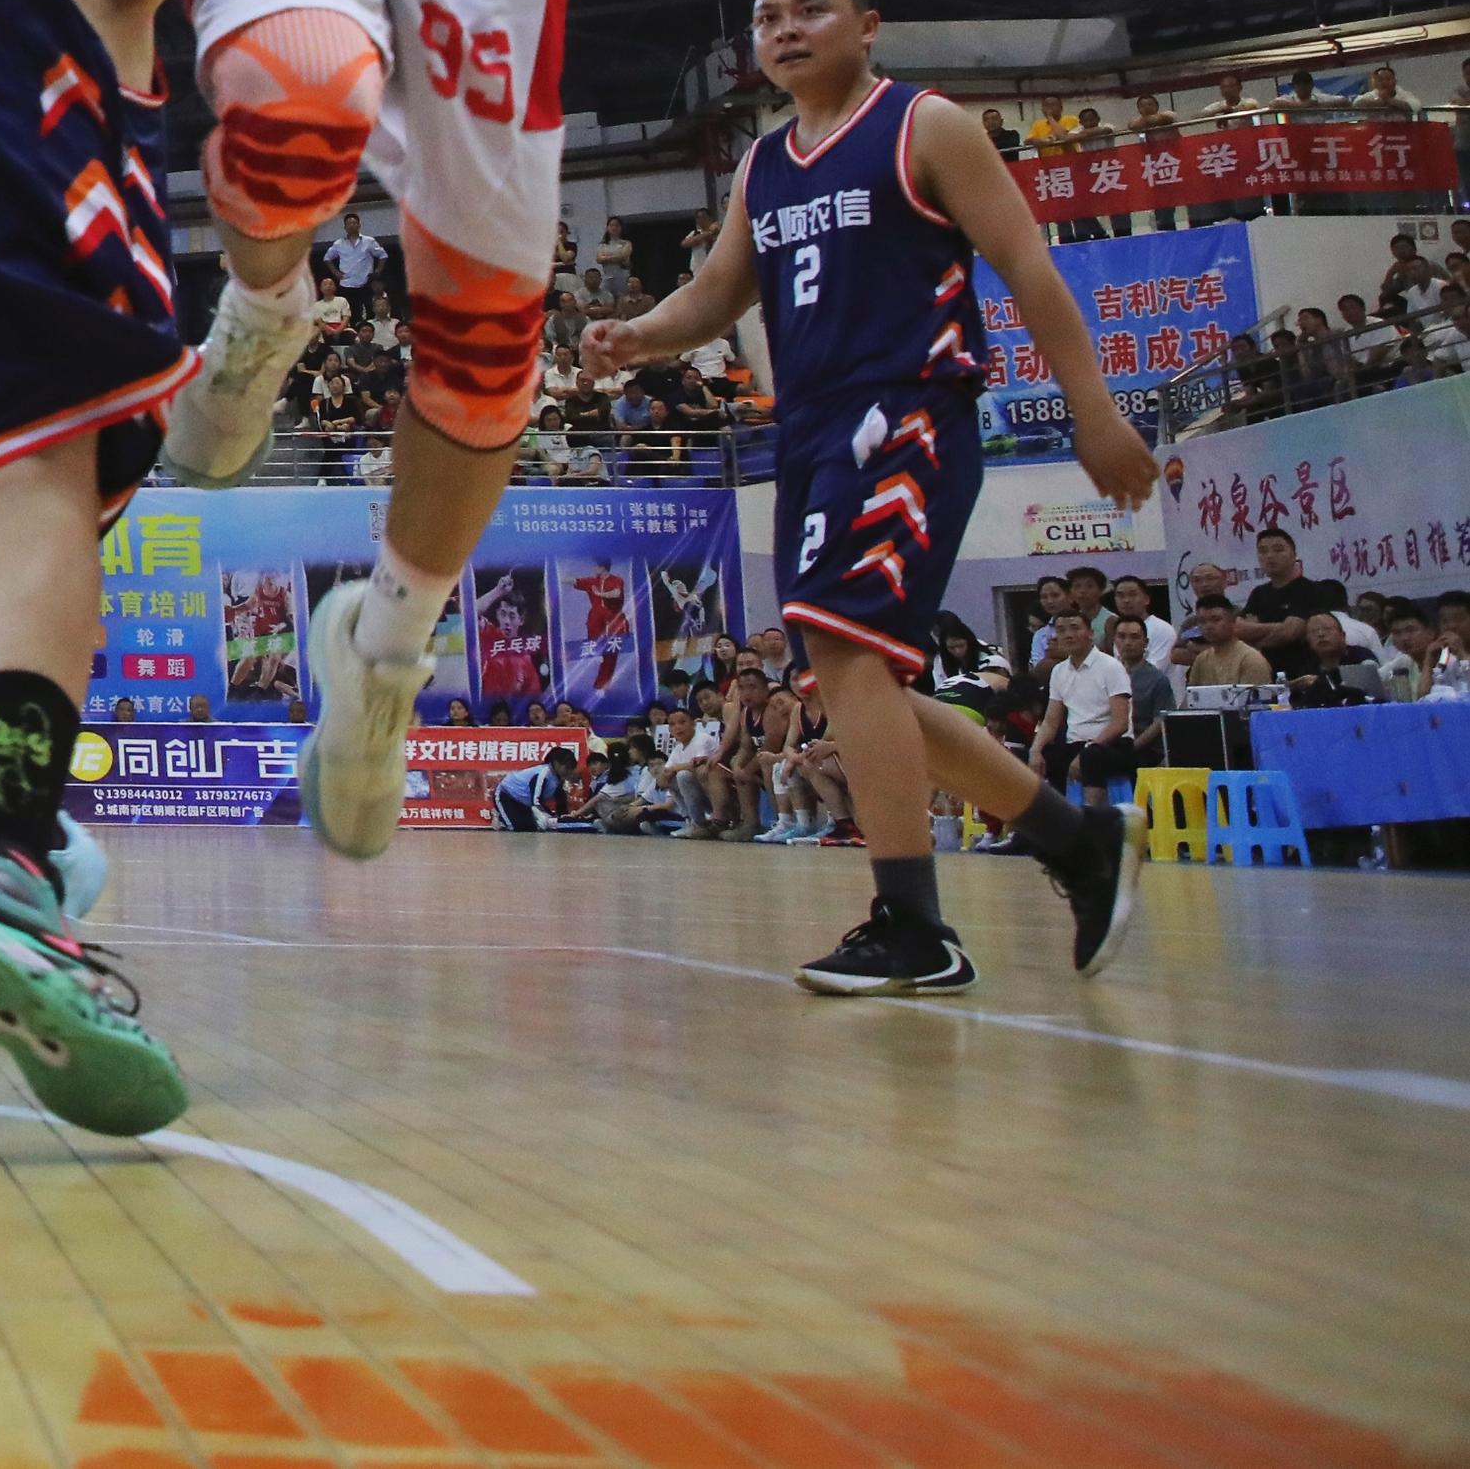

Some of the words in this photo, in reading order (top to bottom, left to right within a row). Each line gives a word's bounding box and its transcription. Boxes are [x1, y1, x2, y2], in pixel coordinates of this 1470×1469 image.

[420, 0, 515, 123] 95
[1035, 134, 1412, 201] 揭发检举见于行
[751, 188, 871, 253] 长顺农信
[793, 244, 820, 307] 2
[1093, 274, 1227, 320] 吉利汽车
[1198, 456, 1357, 541] 神泉谷景区
[798, 512, 826, 574] 2
[1046, 523, 1111, 540] C出口
[137, 658, 186, 677] 舞蹈
[490, 635, 542, 657] 乒乓球
[580, 637, 623, 657] 武术
[118, 738, 299, 778] 同创广告
[106, 790, 183, 801] 13984443012
[195, 790, 273, 801] 18798274673
